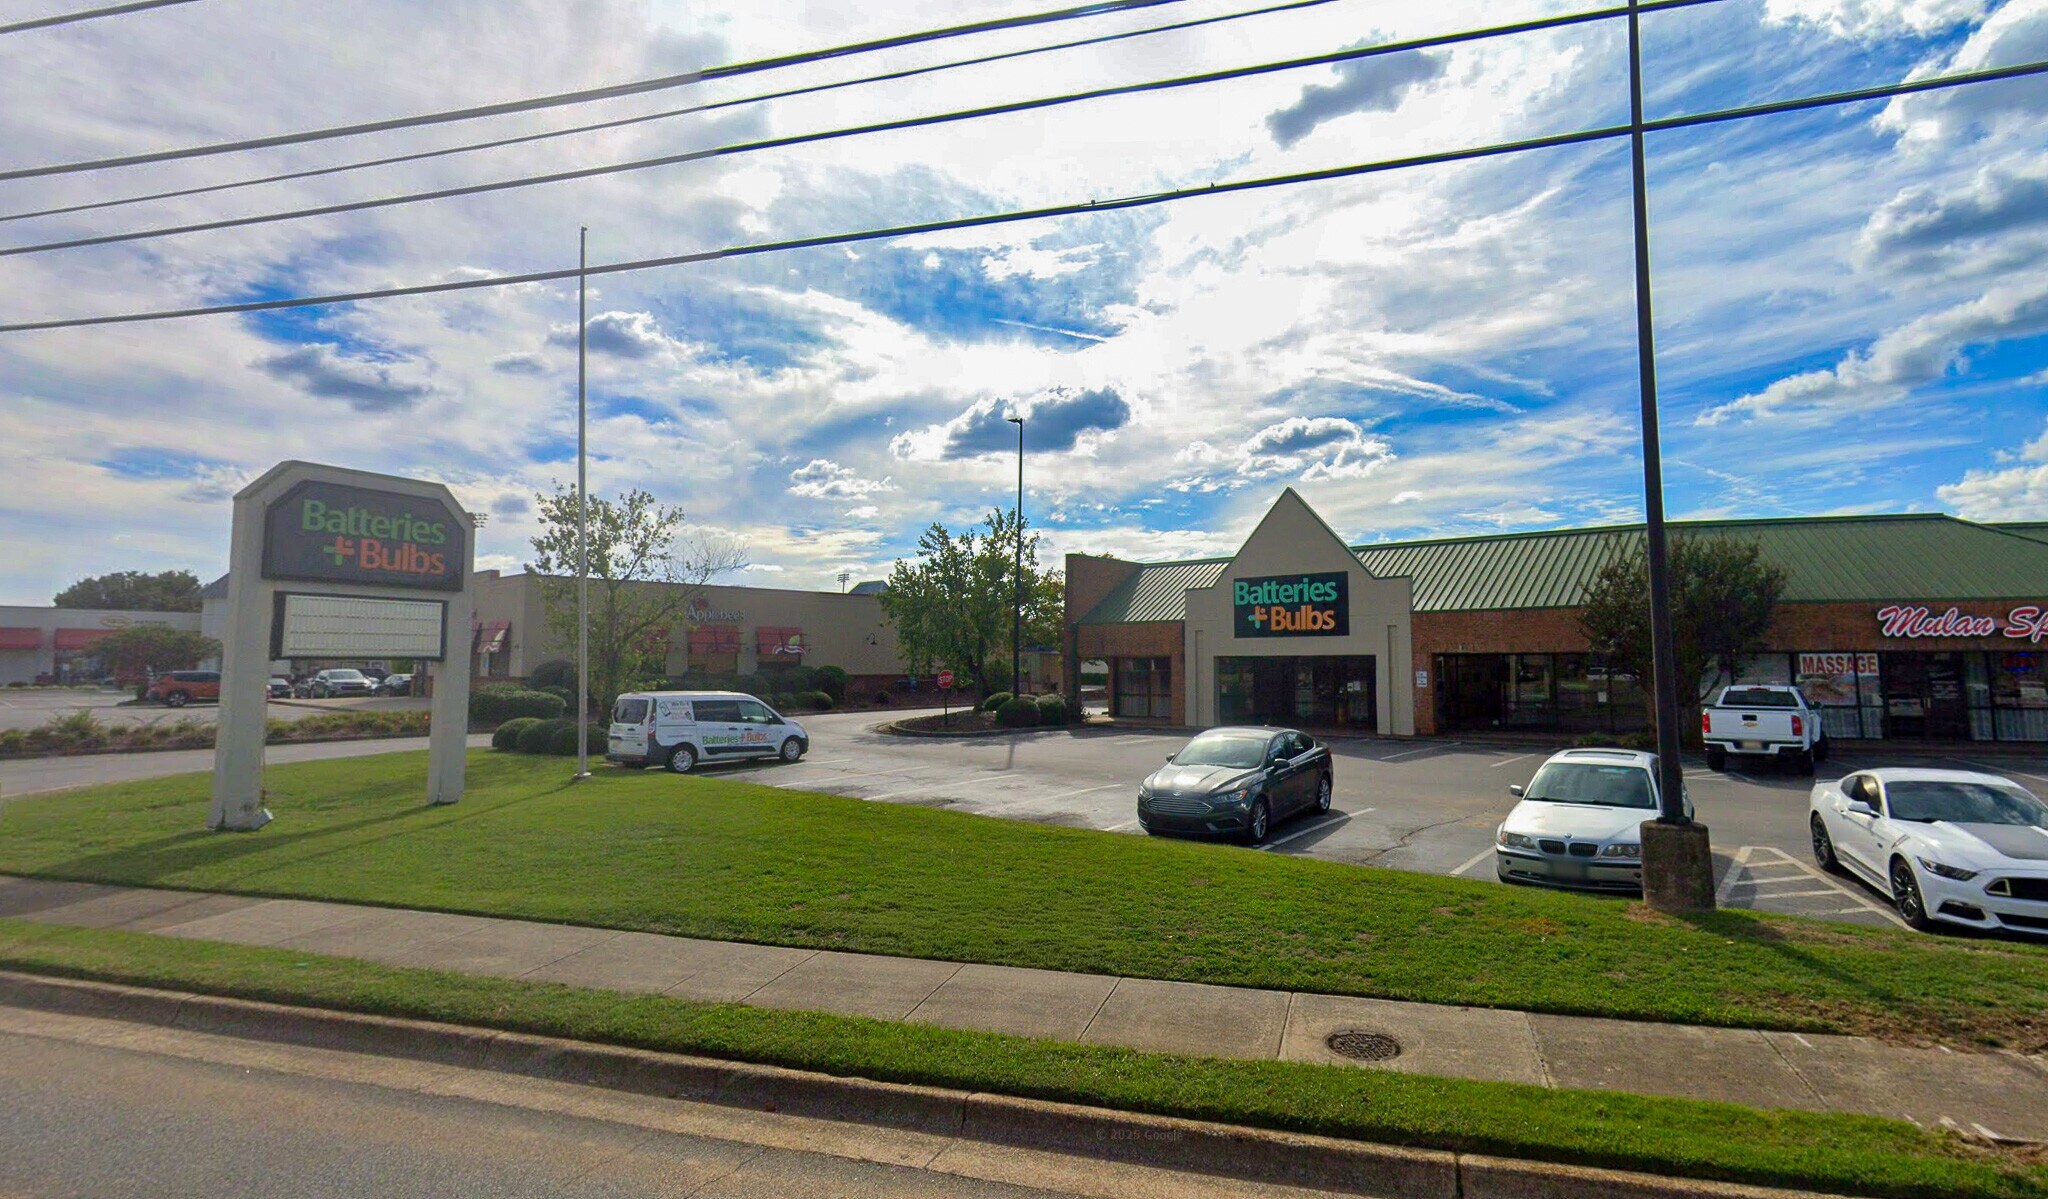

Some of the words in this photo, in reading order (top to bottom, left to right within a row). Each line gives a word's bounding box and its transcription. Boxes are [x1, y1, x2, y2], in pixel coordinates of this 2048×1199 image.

[302, 499, 446, 545] Batteries
[359, 538, 446, 576] Bulbs
[1234, 578, 1338, 605] Batteries
[1270, 604, 1336, 631] Bulbs
[1877, 606, 1995, 638] Mulan
[1802, 655, 1878, 674] MASSAGE
[937, 675, 953, 685] STOP
[702, 735, 739, 745] Batteries
